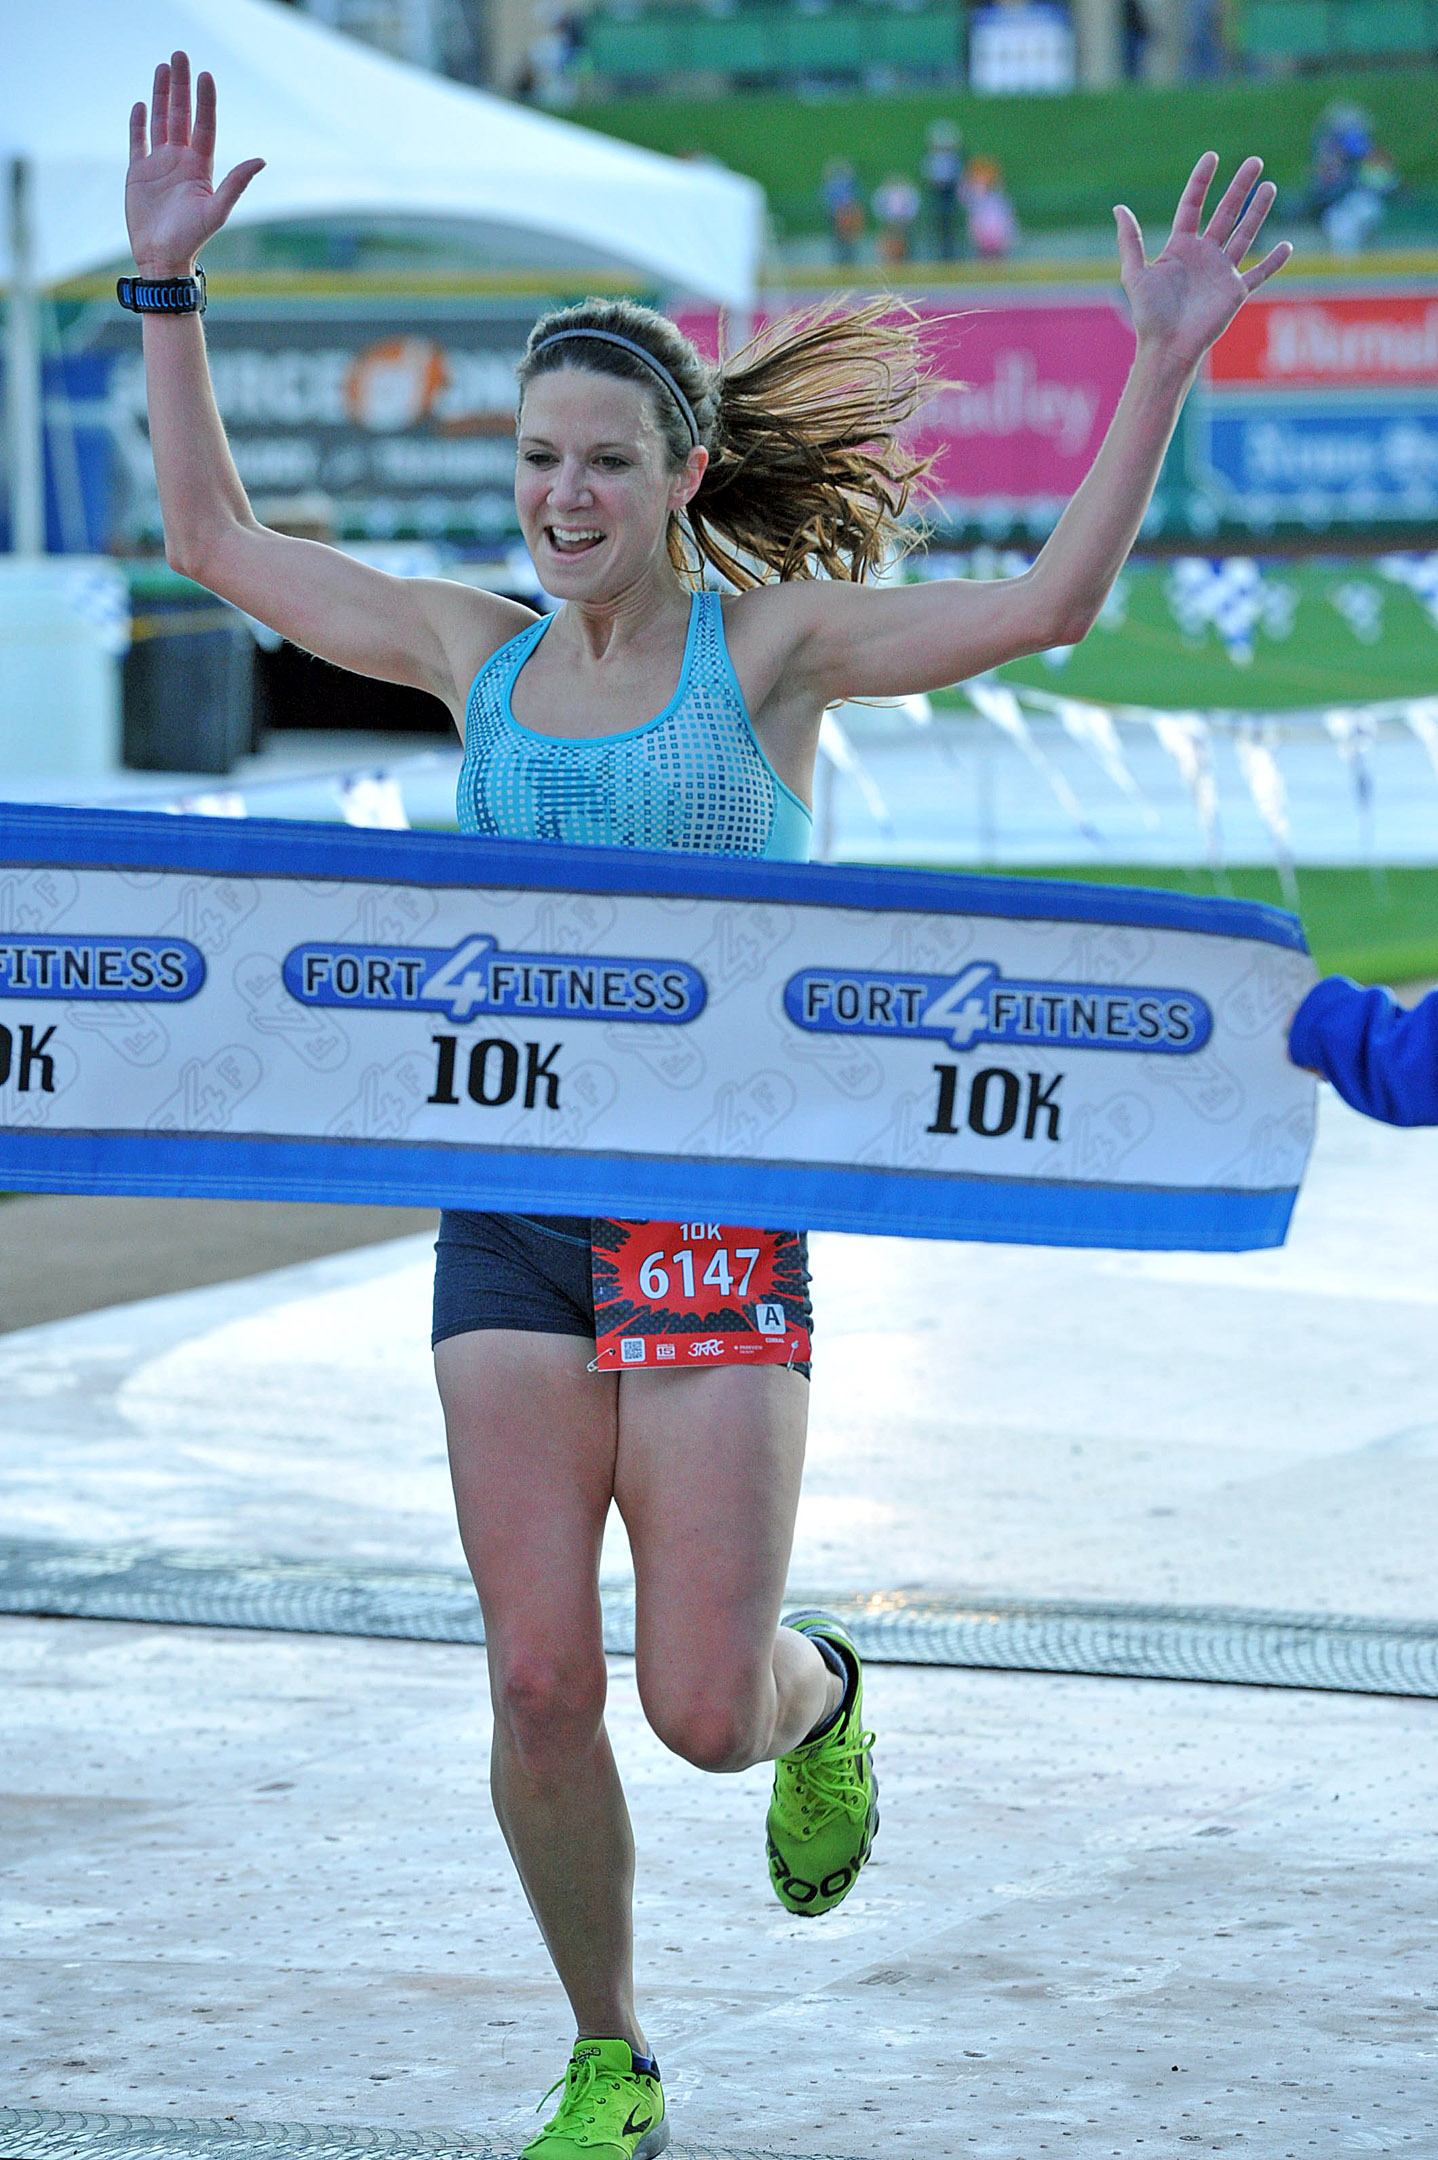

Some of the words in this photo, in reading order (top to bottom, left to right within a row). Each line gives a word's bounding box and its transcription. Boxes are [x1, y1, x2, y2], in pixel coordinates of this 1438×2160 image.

[0, 947, 186, 990] ITNESS
[427, 1035, 563, 1110] 10K
[926, 1064, 1066, 1141] 10K
[680, 1222, 722, 1241] 10K
[638, 1247, 760, 1299] 6147
[764, 1306, 781, 1326] A
